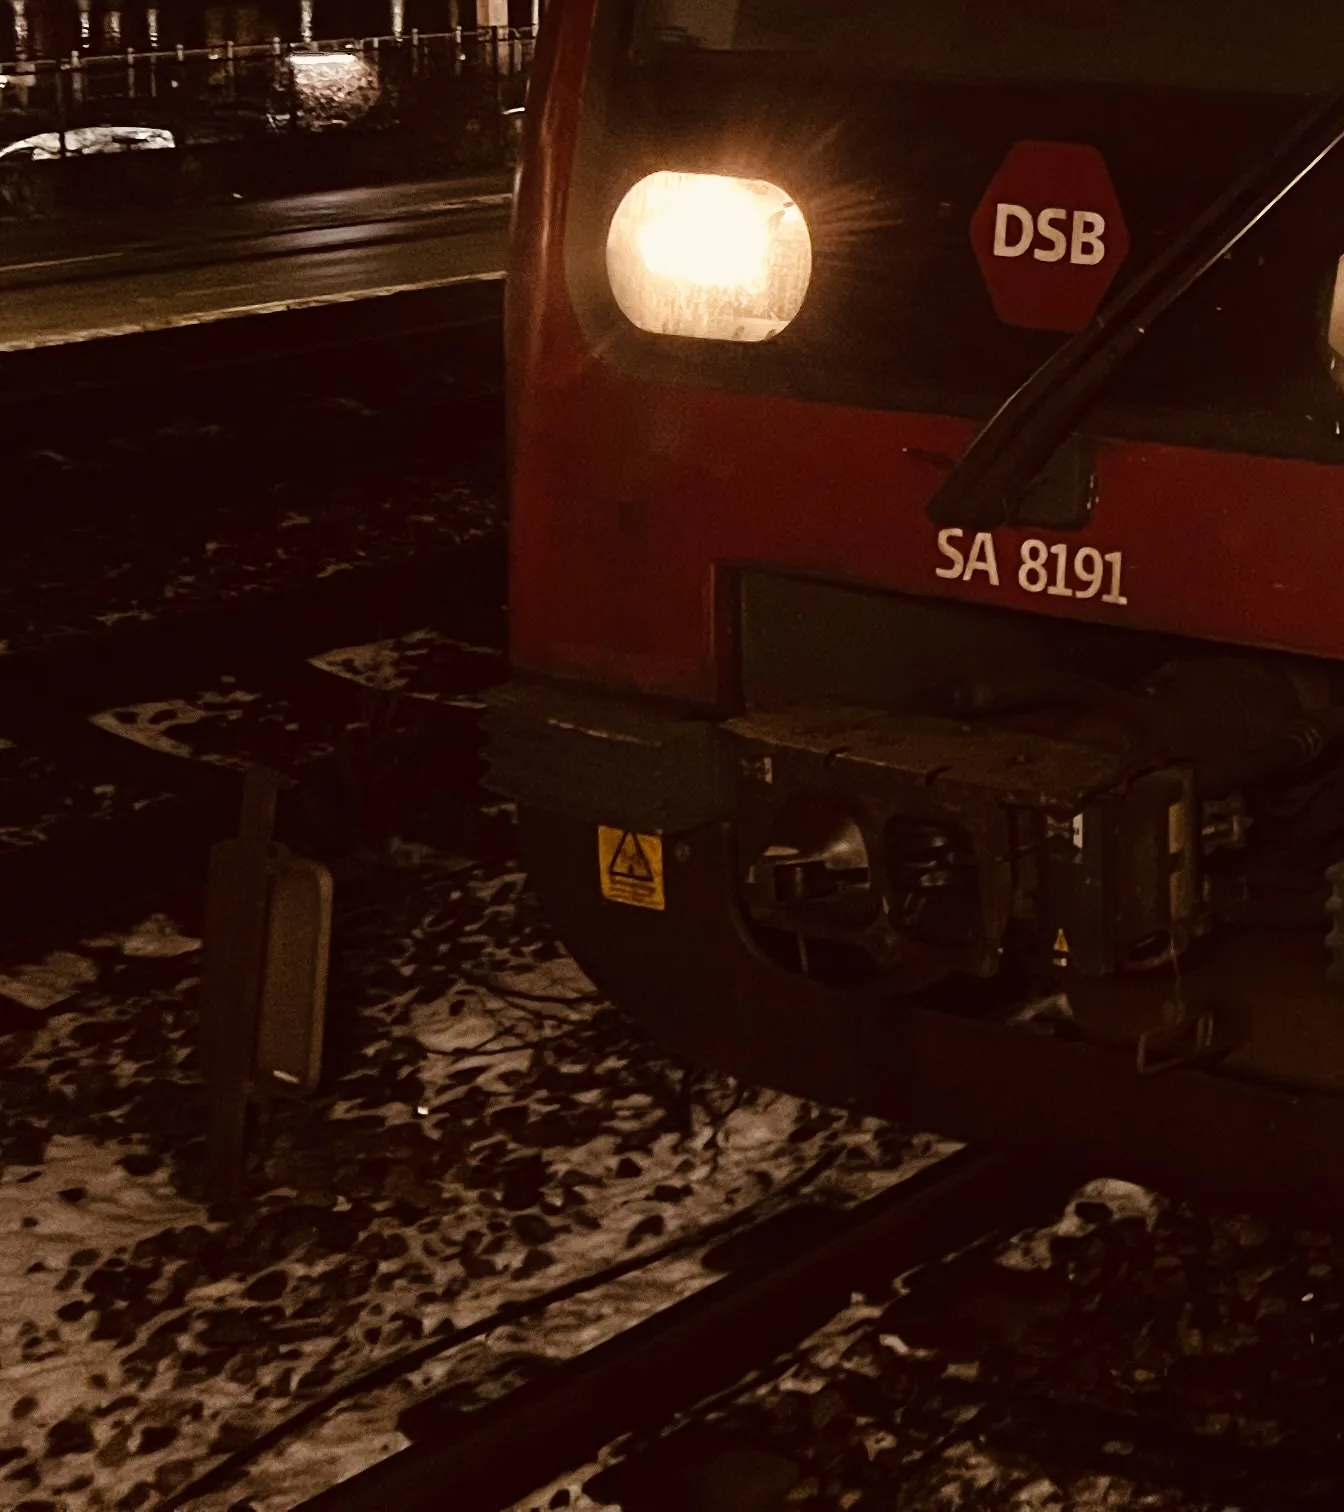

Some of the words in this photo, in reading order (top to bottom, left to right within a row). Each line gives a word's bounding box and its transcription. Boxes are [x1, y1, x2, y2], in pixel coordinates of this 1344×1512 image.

[992, 202, 1107, 266] DSB
[935, 527, 1000, 586] SA
[1017, 538, 1129, 606] 8191
